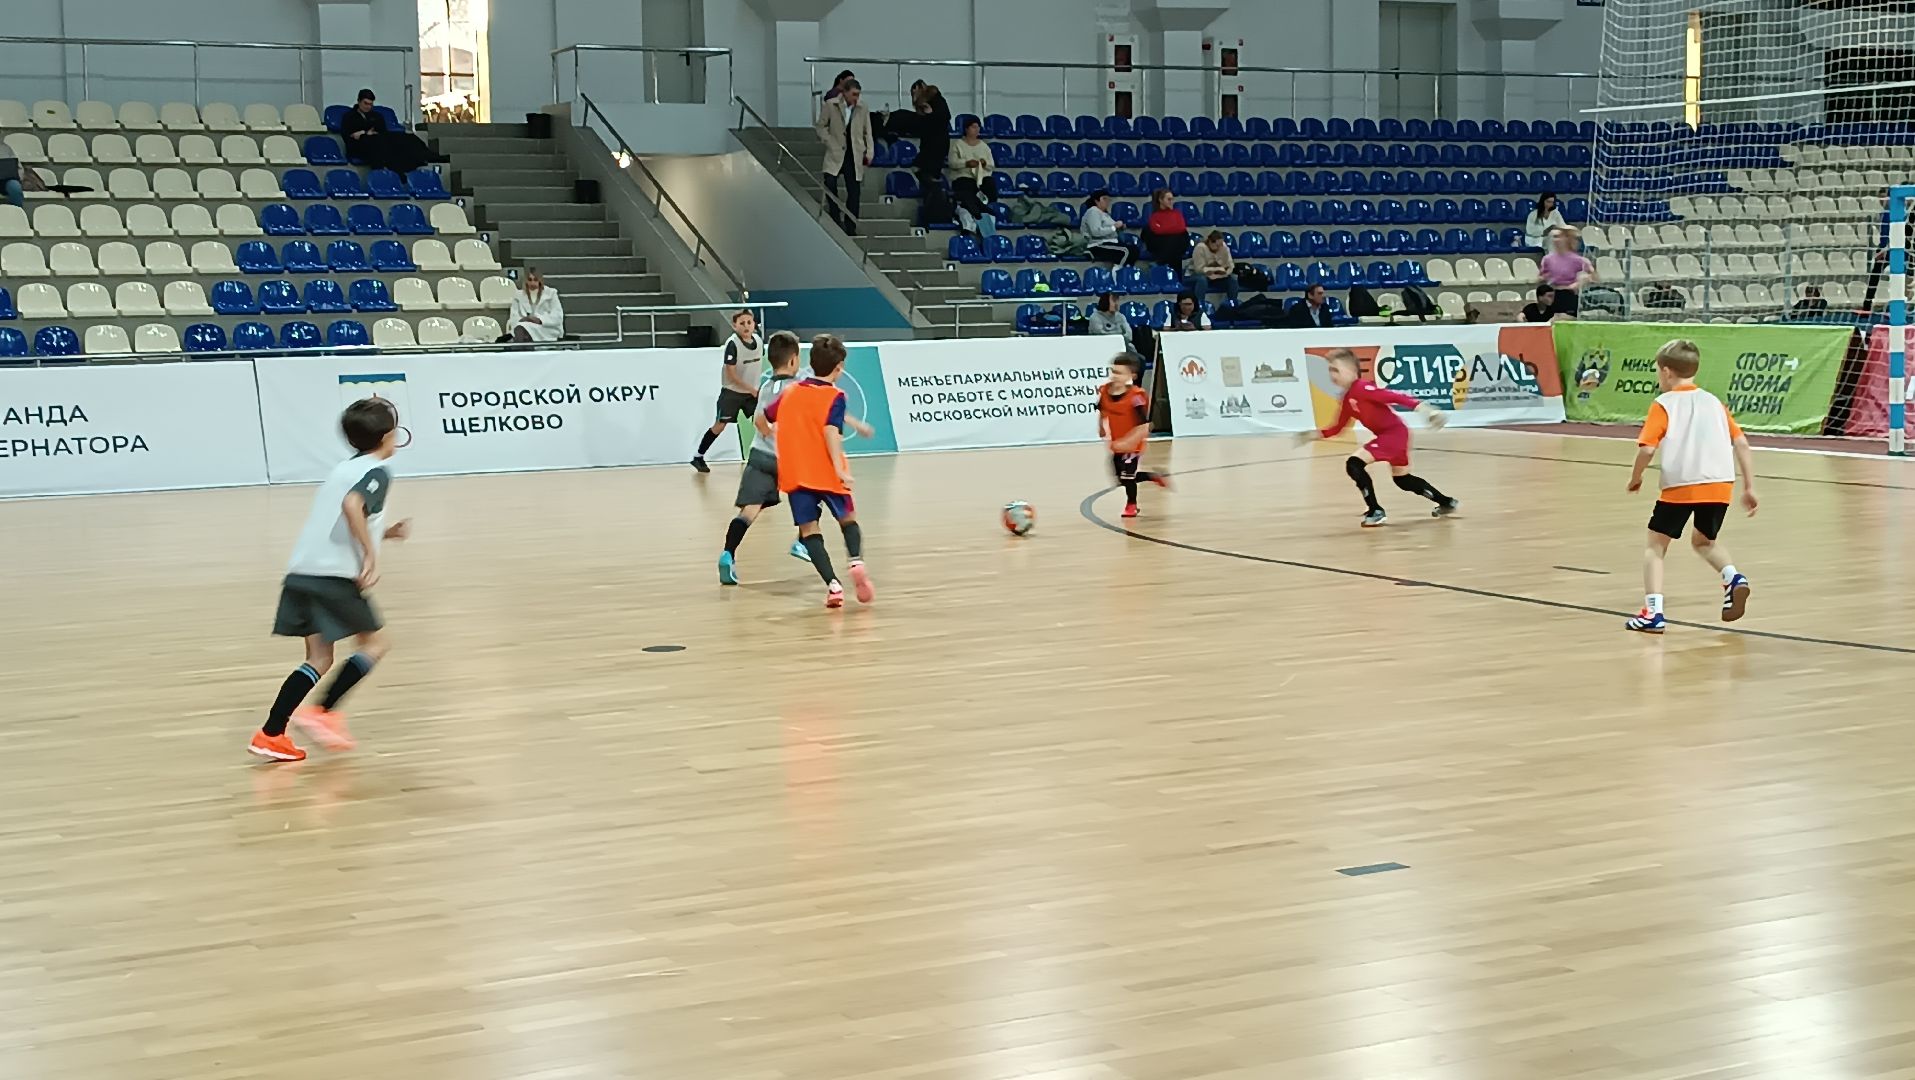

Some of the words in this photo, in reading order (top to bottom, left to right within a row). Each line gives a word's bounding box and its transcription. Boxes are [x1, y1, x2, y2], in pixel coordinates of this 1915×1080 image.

[1736, 352, 1789, 372] СПОРТ
[898, 367, 1065, 387] МЕЖЪЕПАРХИАЛЬНЫЙ
[1728, 373, 1792, 392] НОРМА
[438, 383, 582, 409] ГОРОДСКОЙ
[588, 385, 660, 404] ОКРУГ
[911, 393, 934, 405] ПО
[937, 390, 995, 404] РАБОТЕ
[997, 389, 1008, 401] С
[1727, 393, 1785, 415] ЖИЗНИ
[3, 405, 89, 427] АНДА
[909, 405, 1013, 423] МОСКОВСКОЙ
[442, 414, 563, 437] ЩЕЛКОВО
[0, 435, 149, 457] ЕРНАТОРА
